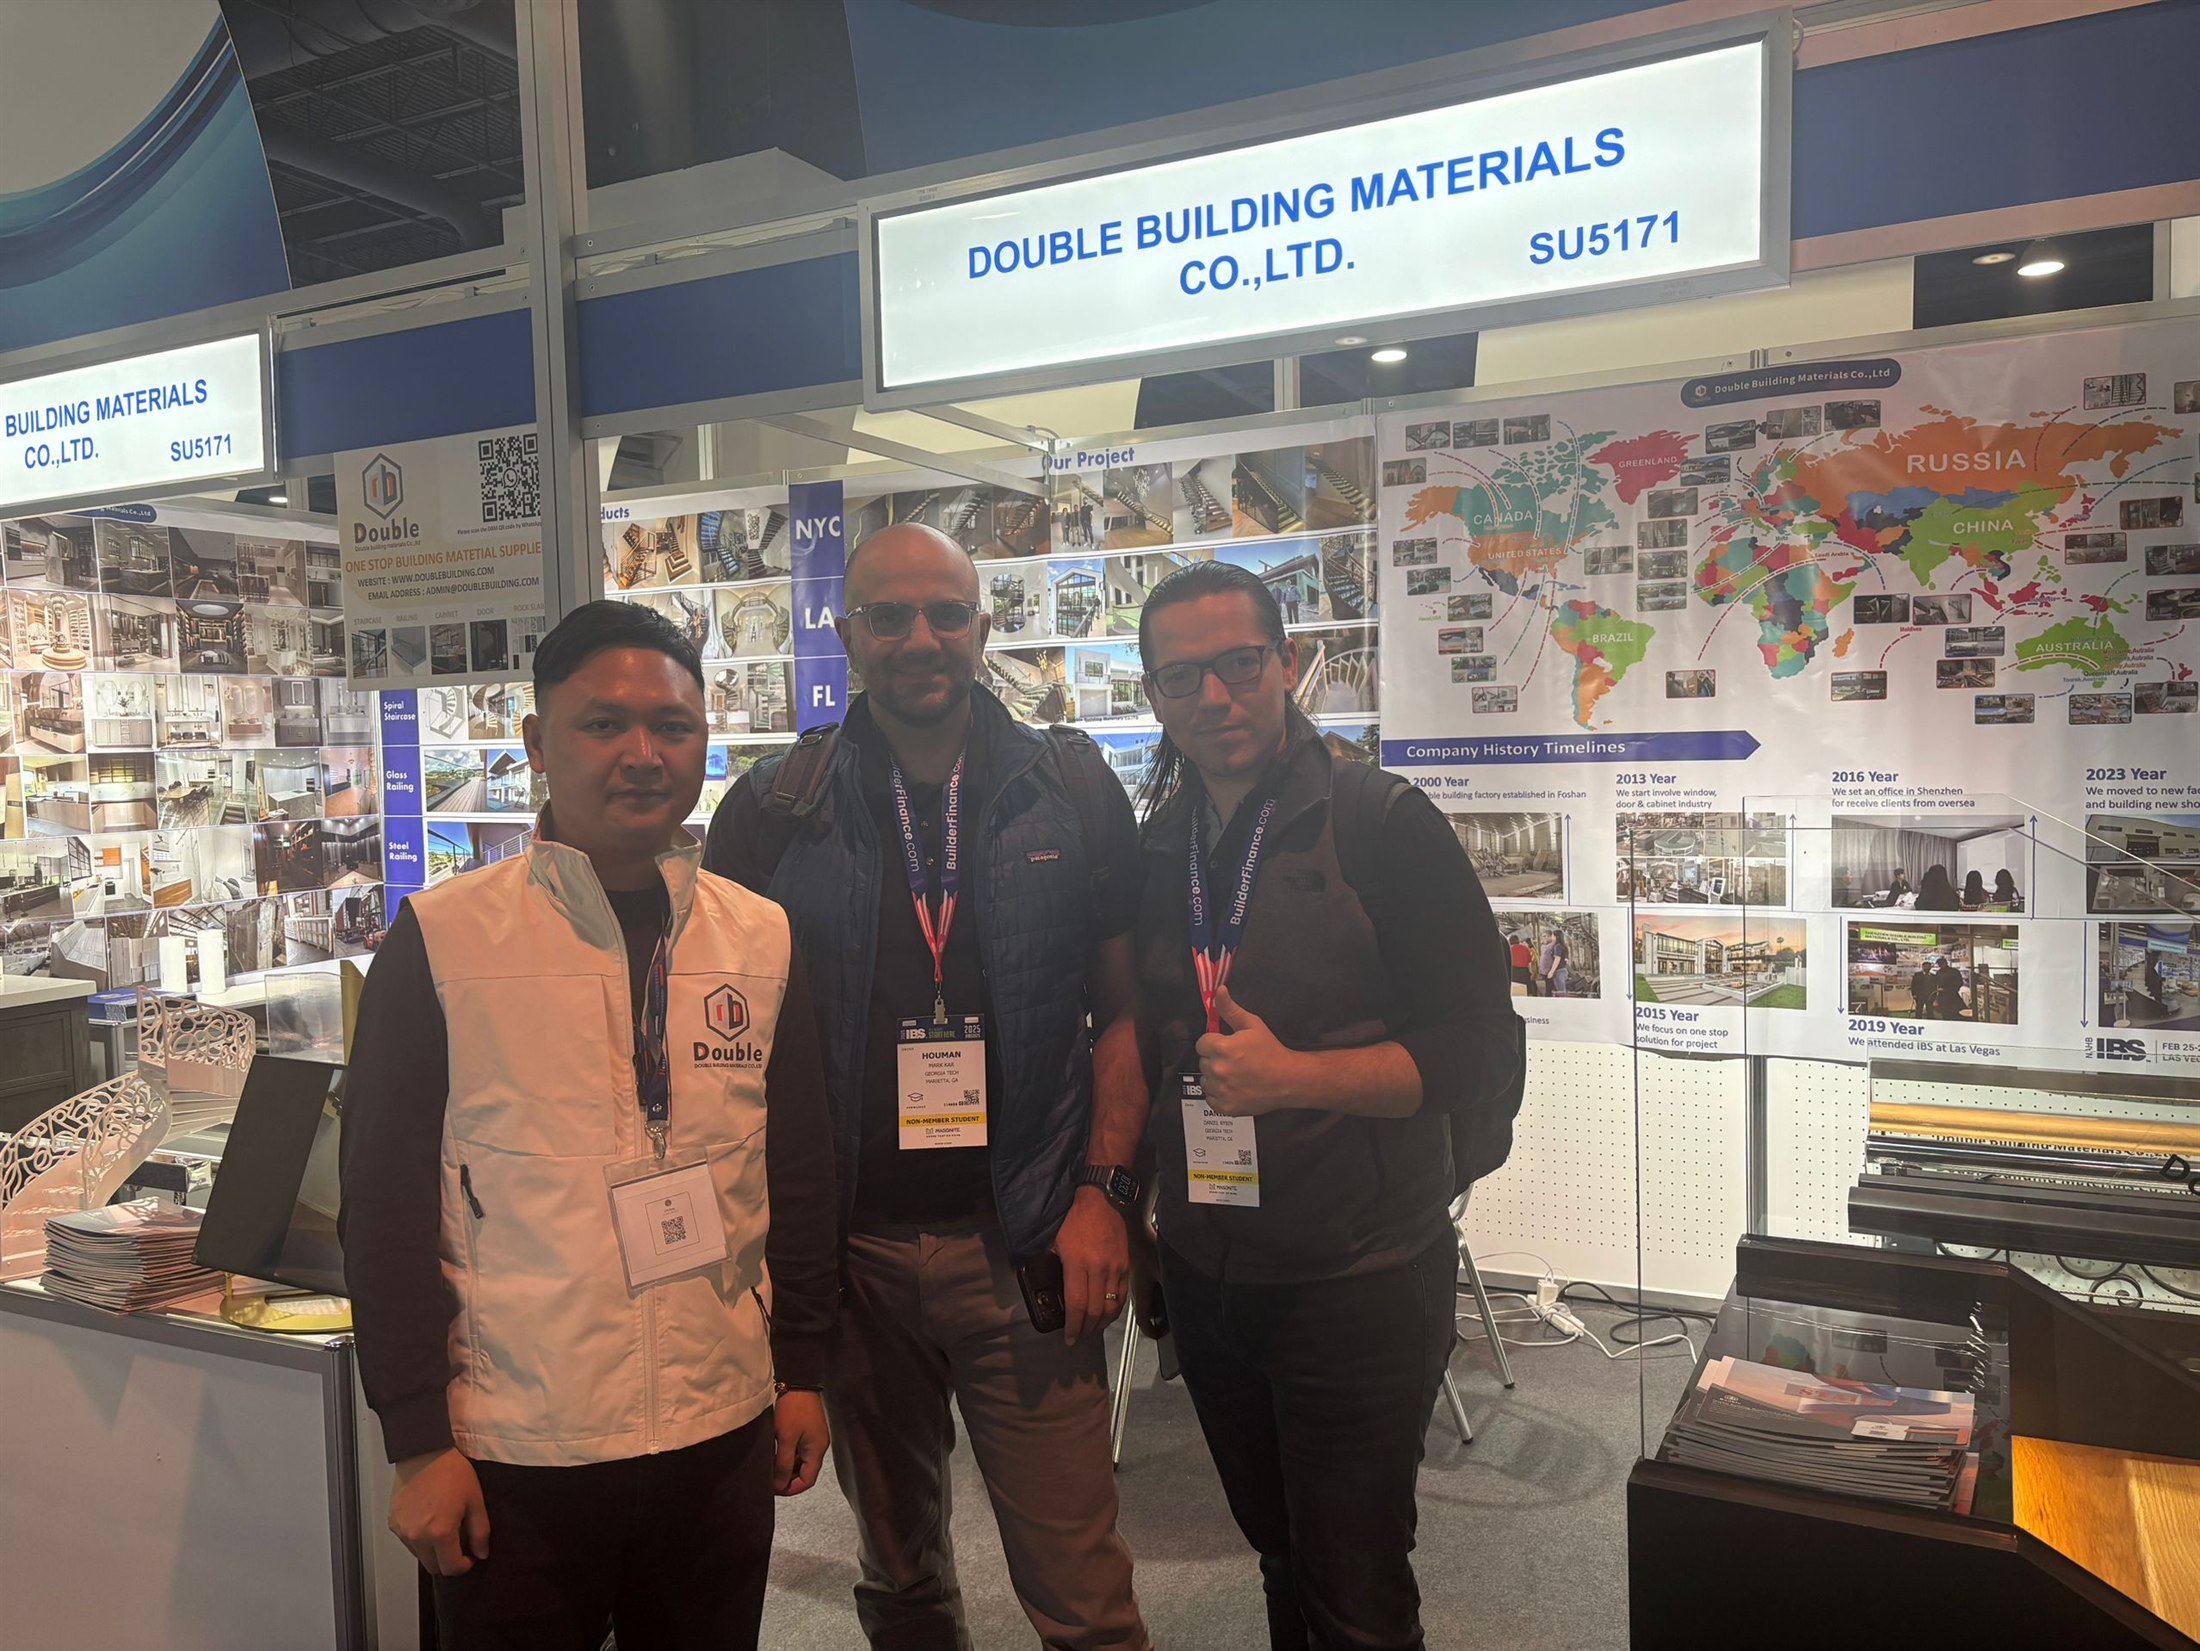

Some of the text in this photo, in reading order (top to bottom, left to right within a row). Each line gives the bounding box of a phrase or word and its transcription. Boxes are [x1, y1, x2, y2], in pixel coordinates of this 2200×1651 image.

[969, 128, 1624, 278] DOUBLE BUILDING MATERIALS
[1531, 212, 1680, 264] SU5171
[1180, 239, 1354, 294] CO.,LTD.
[1714, 368, 1891, 393] Double Building Materials Co.,Ltd
[6, 380, 207, 436] BUILDING MATERIALS
[25, 438, 99, 468] CO.,LTD.
[171, 434, 232, 461] SU5171
[1077, 448, 1135, 469] Project
[1618, 455, 1678, 468] GREENLAND
[1907, 449, 2026, 473] RUSSIA
[1473, 510, 1533, 526] CANADA
[354, 517, 420, 544] Double
[795, 516, 841, 541] NYC
[1953, 519, 2014, 534] CHINA
[345, 560, 366, 573] ONE
[368, 557, 393, 571] STOP
[396, 552, 443, 568] BUILDING
[445, 547, 497, 564] MATETIAL
[1488, 547, 1562, 560] UNITED STATES
[358, 566, 495, 588] WEBSITE WWW.DOUBLEBUILDING.COM
[368, 577, 540, 601] EMAIL ADDRESS ADMIN@DOUBLEBUILDING.COM
[804, 606, 835, 630] LA
[1592, 631, 1634, 644] BRAZIL
[2035, 640, 2114, 653] AUSTRALIA
[813, 685, 836, 707] FL
[384, 701, 404, 712] Spiral
[384, 712, 416, 721] Staircase
[1406, 740, 1626, 763] Company History Timelines
[386, 770, 408, 780] Glass
[1413, 775, 1470, 788] 2000 Year
[1616, 772, 1677, 785] 2013 Year
[1831, 770, 1900, 783] 2016 Year
[2085, 767, 2167, 782] 2023 Year
[386, 782, 415, 793] Railing
[1616, 787, 1718, 798] We start involve window,
[1831, 787, 1846, 797] We
[1847, 787, 1861, 796] set
[1877, 786, 1904, 796] office
[1906, 787, 1915, 796] in
[1917, 786, 1963, 796] Shenzhen
[2085, 786, 2103, 796] We
[2106, 785, 2143, 795] moved
[2146, 787, 2159, 795] to
[2160, 788, 2180, 796] new
[1442, 791, 1473, 801] building
[1474, 791, 1501, 800] factory
[1502, 790, 1546, 799] established
[1547, 790, 1556, 798] in
[1557, 790, 1587, 799] Foshan
[1616, 799, 1713, 811] door & cabinet industry
[1831, 798, 1976, 809] for receive clients from oversea
[2085, 799, 2106, 809] and
[2108, 798, 2153, 811] building
[2155, 800, 2179, 809] new
[389, 842, 409, 851] Steel
[389, 852, 418, 863] Railing
[1230, 798, 1276, 926] BuilderFinance.com
[1636, 1007, 1699, 1022] 2015 Year
[906, 1028, 926, 1040] IBS
[964, 1025, 981, 1034] 2025
[1636, 1023, 1729, 1039] We focus on one stop
[1848, 1019, 1925, 1035] 2019 Year
[1636, 1035, 1718, 1050] solution for project
[1848, 1036, 2001, 1057] We attended IBS at Las Vegas
[2096, 1038, 2147, 1062] IBS
[2162, 1042, 2181, 1051] FEB
[693, 1041, 763, 1062] Double
[921, 1051, 962, 1060] HOUMAN
[2162, 1053, 2182, 1062] LAS
[1187, 1085, 1203, 1096] IBS
[1193, 1173, 1253, 1183] NON-MEMBER STUDENT
